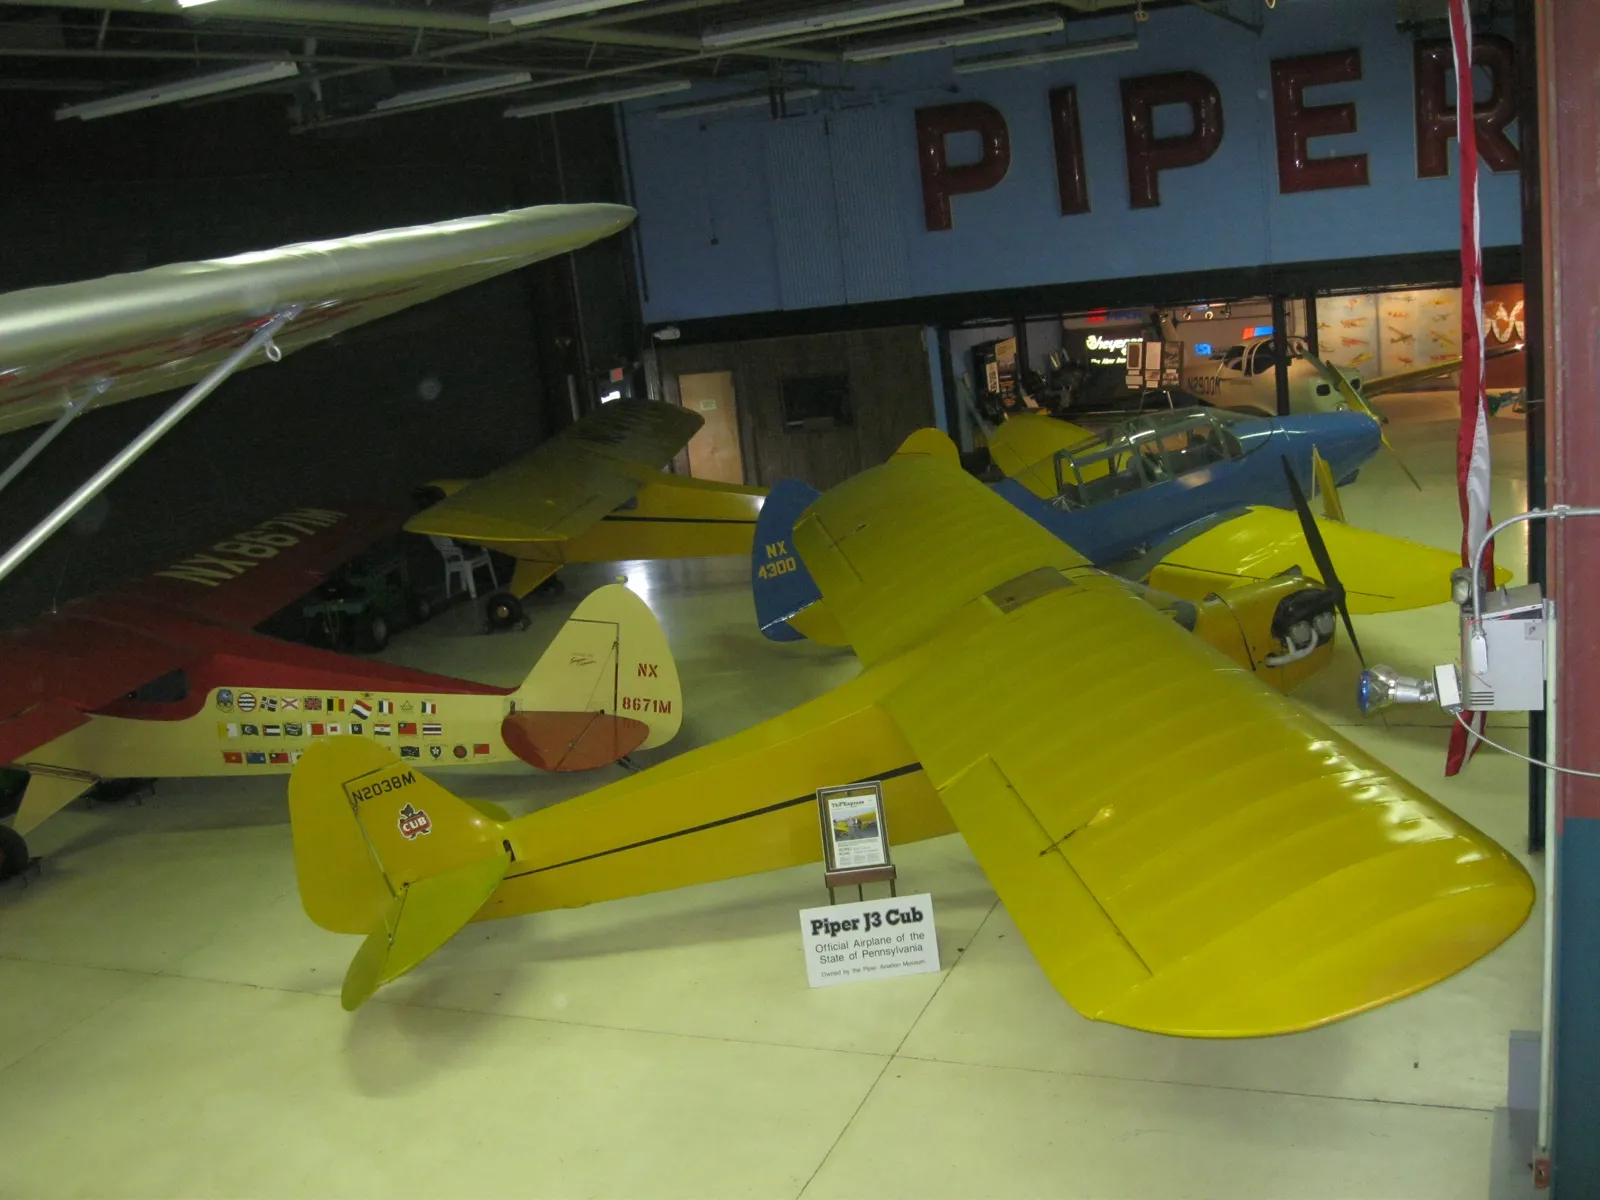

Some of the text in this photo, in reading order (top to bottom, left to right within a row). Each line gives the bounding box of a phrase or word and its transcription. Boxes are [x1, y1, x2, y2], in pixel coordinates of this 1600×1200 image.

[914, 35, 1522, 232] PIPER
[153, 507, 349, 587] NX8671M
[765, 540, 788, 559] NX
[758, 556, 797, 580] 4300
[637, 662, 659, 678] NX
[622, 696, 672, 714] 8671M
[351, 770, 417, 804] N2038M
[402, 816, 428, 832] CUB
[810, 906, 924, 938] Piper J3 Cub
[815, 931, 925, 953] Official Airplane of the
[820, 944, 923, 965] State of Pennsylvania
[821, 970, 841, 978] Owned
[902, 959, 925, 967] Museum
